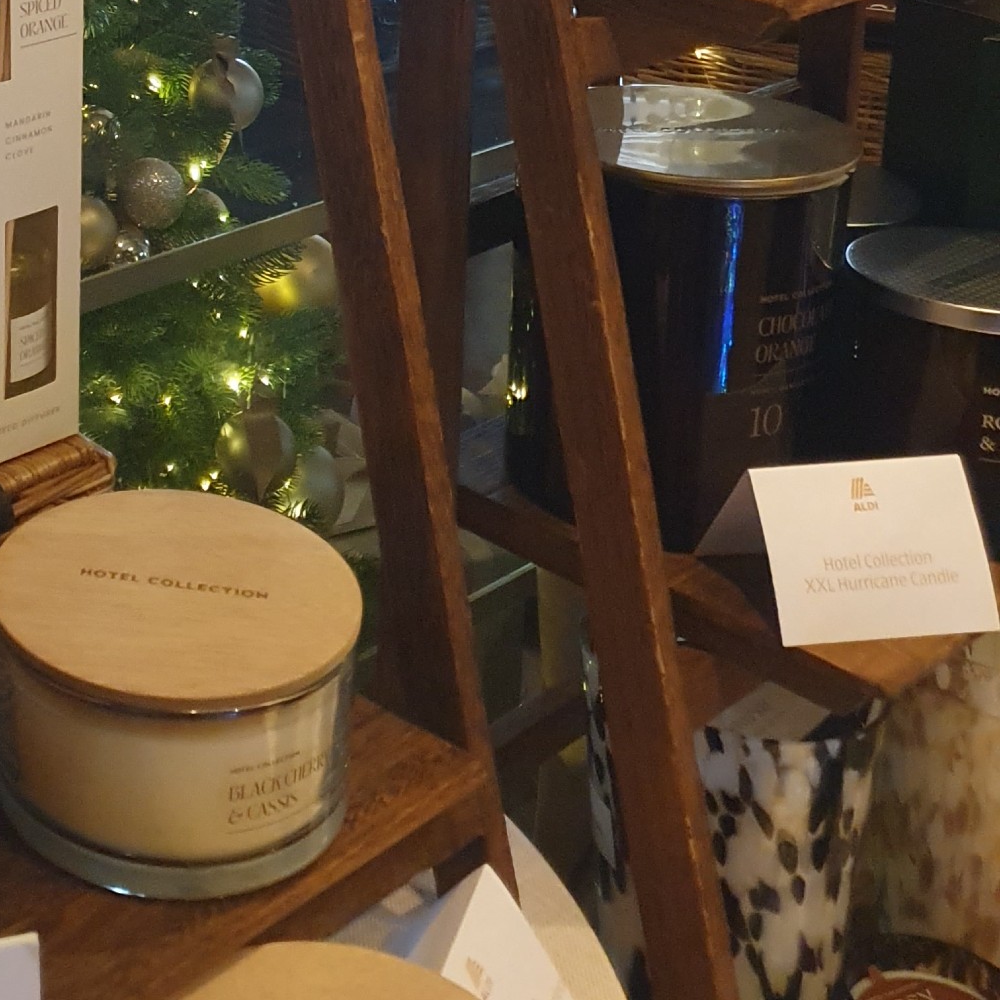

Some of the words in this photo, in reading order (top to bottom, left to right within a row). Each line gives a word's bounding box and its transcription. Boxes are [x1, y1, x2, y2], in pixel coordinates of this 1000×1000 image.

[19, 13, 69, 39] ORANGE
[5, 111, 51, 129] MANDARIN
[5, 126, 53, 145] CINNAMON
[5, 148, 34, 161] CLOVE
[750, 403, 783, 439] 10
[980, 436, 996, 452] &
[854, 501, 879, 513] ALDI
[823, 555, 861, 572] Hotel
[864, 550, 933, 569] Collection
[80, 567, 139, 583] HOTEL
[148, 576, 269, 600] COLLECTION
[804, 577, 836, 594] XXL
[838, 574, 907, 592] Hurricane
[910, 569, 959, 587] Candle
[228, 777, 281, 802] BLACK
